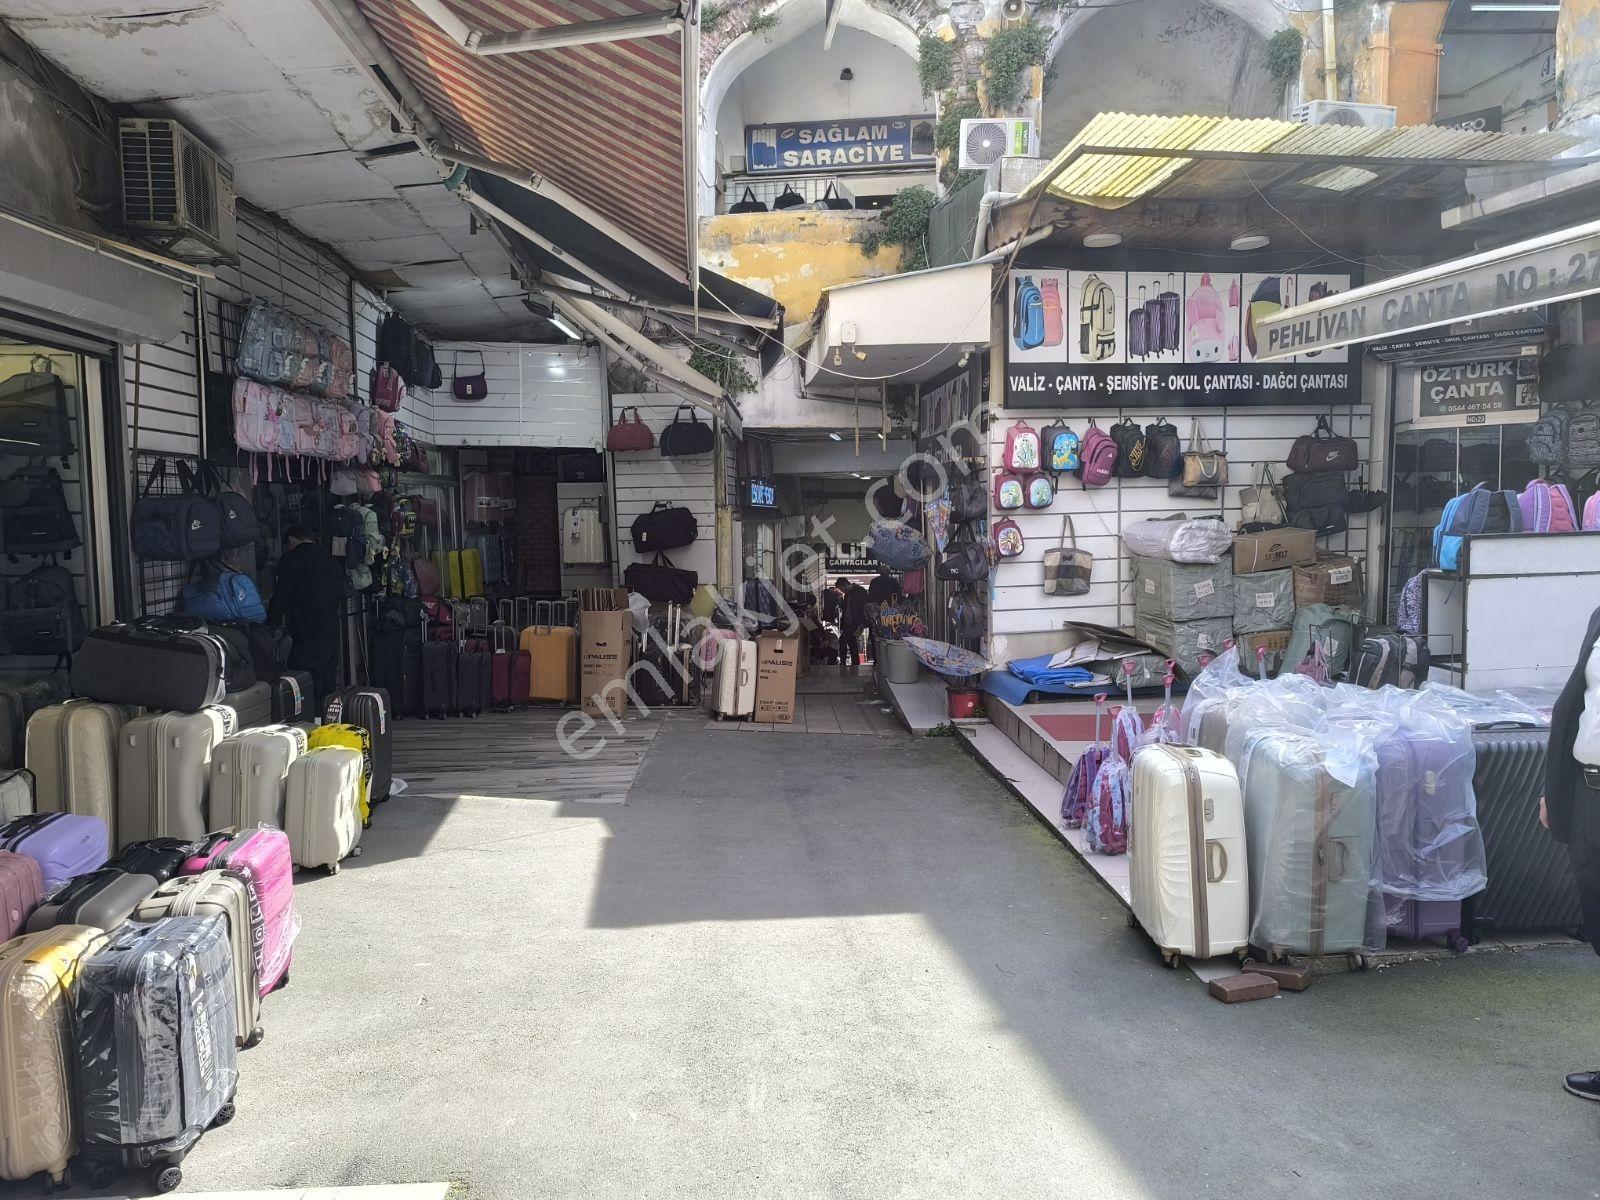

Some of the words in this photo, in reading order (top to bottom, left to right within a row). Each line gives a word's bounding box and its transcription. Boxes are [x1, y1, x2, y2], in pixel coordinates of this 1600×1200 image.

[798, 123, 889, 145] SAĞLAM
[783, 141, 905, 168] SARACİYE
[1269, 306, 1366, 351] PEHLİVAN
[1496, 265, 1539, 301] NO
[1568, 249, 1600, 289] 27
[1009, 372, 1046, 392] VALİZ
[1055, 375, 1097, 395] ÇANTA
[1106, 371, 1159, 395] ŞEMSİYE
[1168, 374, 1201, 391] OKUL
[1203, 374, 1253, 394] ÇANTASI
[1262, 371, 1297, 390] DAĞCI
[1300, 373, 1348, 393] ÇANTASI
[1422, 360, 1514, 383] ÖZTÜRK
[1430, 380, 1504, 404] ÇANTA
[829, 559, 878, 567] ÇANTACILAR
